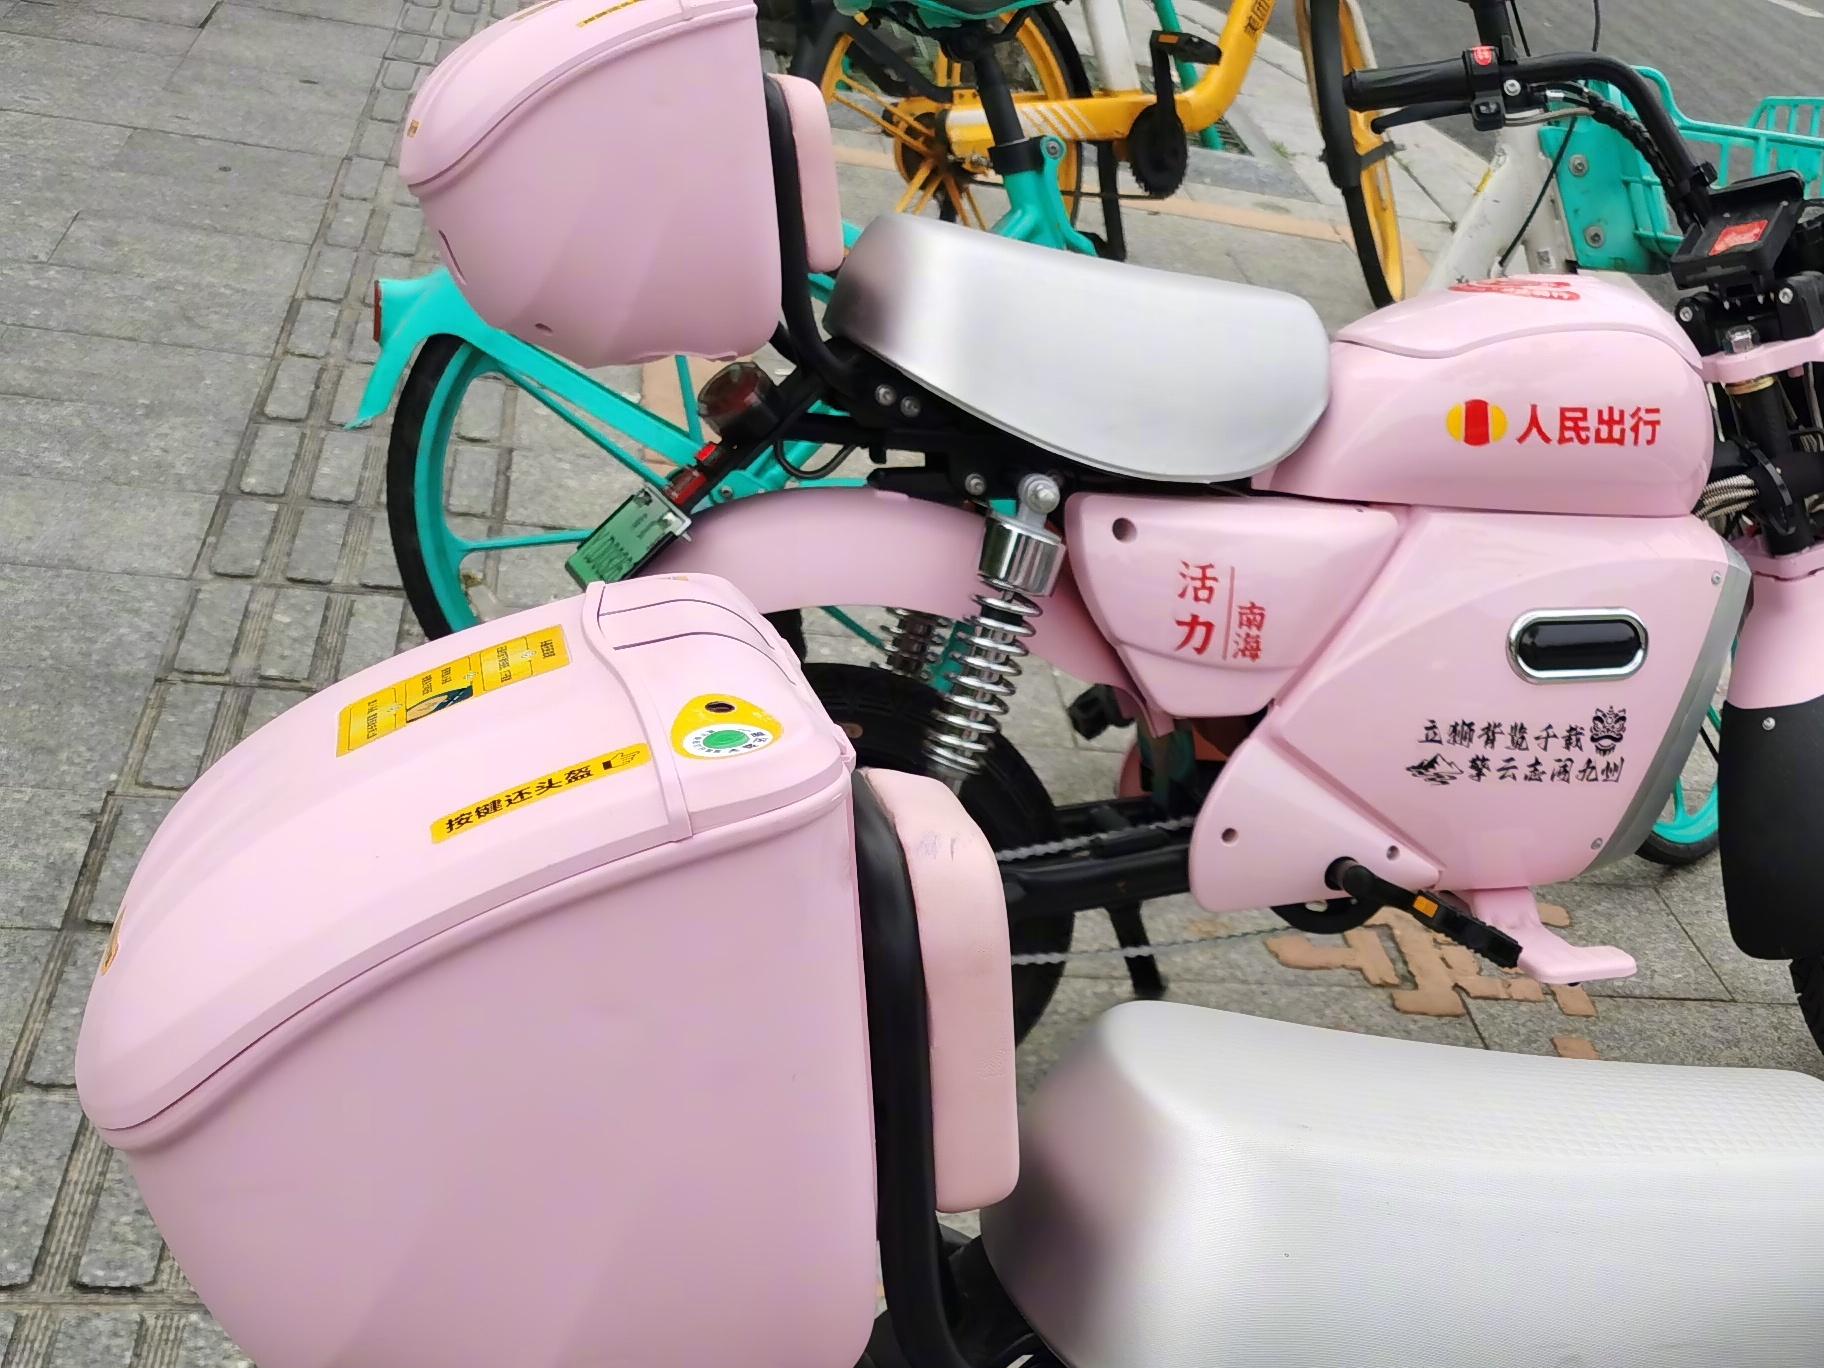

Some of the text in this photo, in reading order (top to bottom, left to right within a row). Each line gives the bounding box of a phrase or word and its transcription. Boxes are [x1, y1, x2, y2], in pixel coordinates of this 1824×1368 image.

[1516, 403, 1661, 447] 人民出行
[1174, 560, 1219, 655] 活力
[1232, 601, 1266, 663] 南海
[445, 764, 594, 834] 按键还头盔
